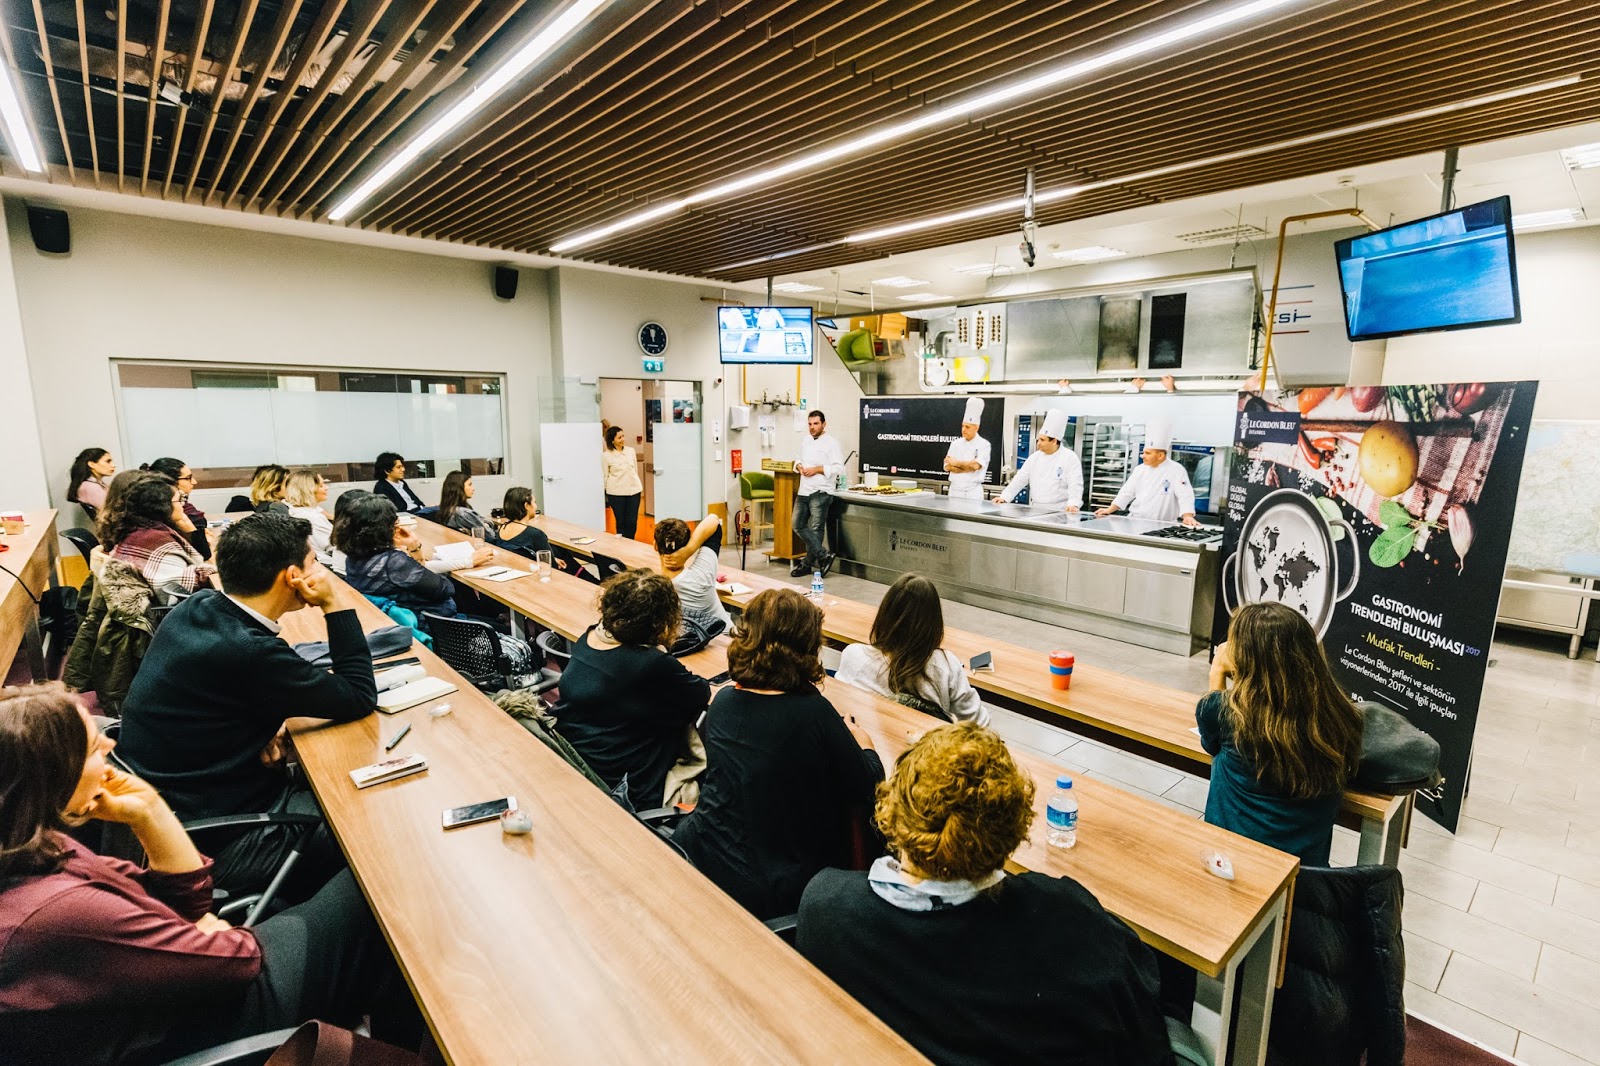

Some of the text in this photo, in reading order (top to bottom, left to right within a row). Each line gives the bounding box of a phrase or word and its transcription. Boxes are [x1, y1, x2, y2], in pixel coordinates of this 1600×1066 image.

[877, 433, 910, 441] GASTRONOMİ
[910, 434, 939, 442] TRENDLERİ
[1256, 421, 1279, 429] CORDON
[1280, 421, 1296, 430] BLEU
[1230, 485, 1247, 495] GLOBAL
[1228, 501, 1246, 511] GLOBAL
[907, 539, 931, 549] CORDON
[932, 543, 948, 552] BLEU
[1372, 594, 1443, 629] GASTRONOMİ
[1350, 602, 1481, 657] TRENDLERİ BULUŞMASI 2017
[1366, 631, 1396, 654] Mutfak
[1397, 643, 1435, 671] Trendleri
[1344, 644, 1456, 705] Le Cordon Bleu şefleri ve sektörün
[1340, 656, 1458, 721] vizyonerlerinden 2017 ile ilgili ipuçları
